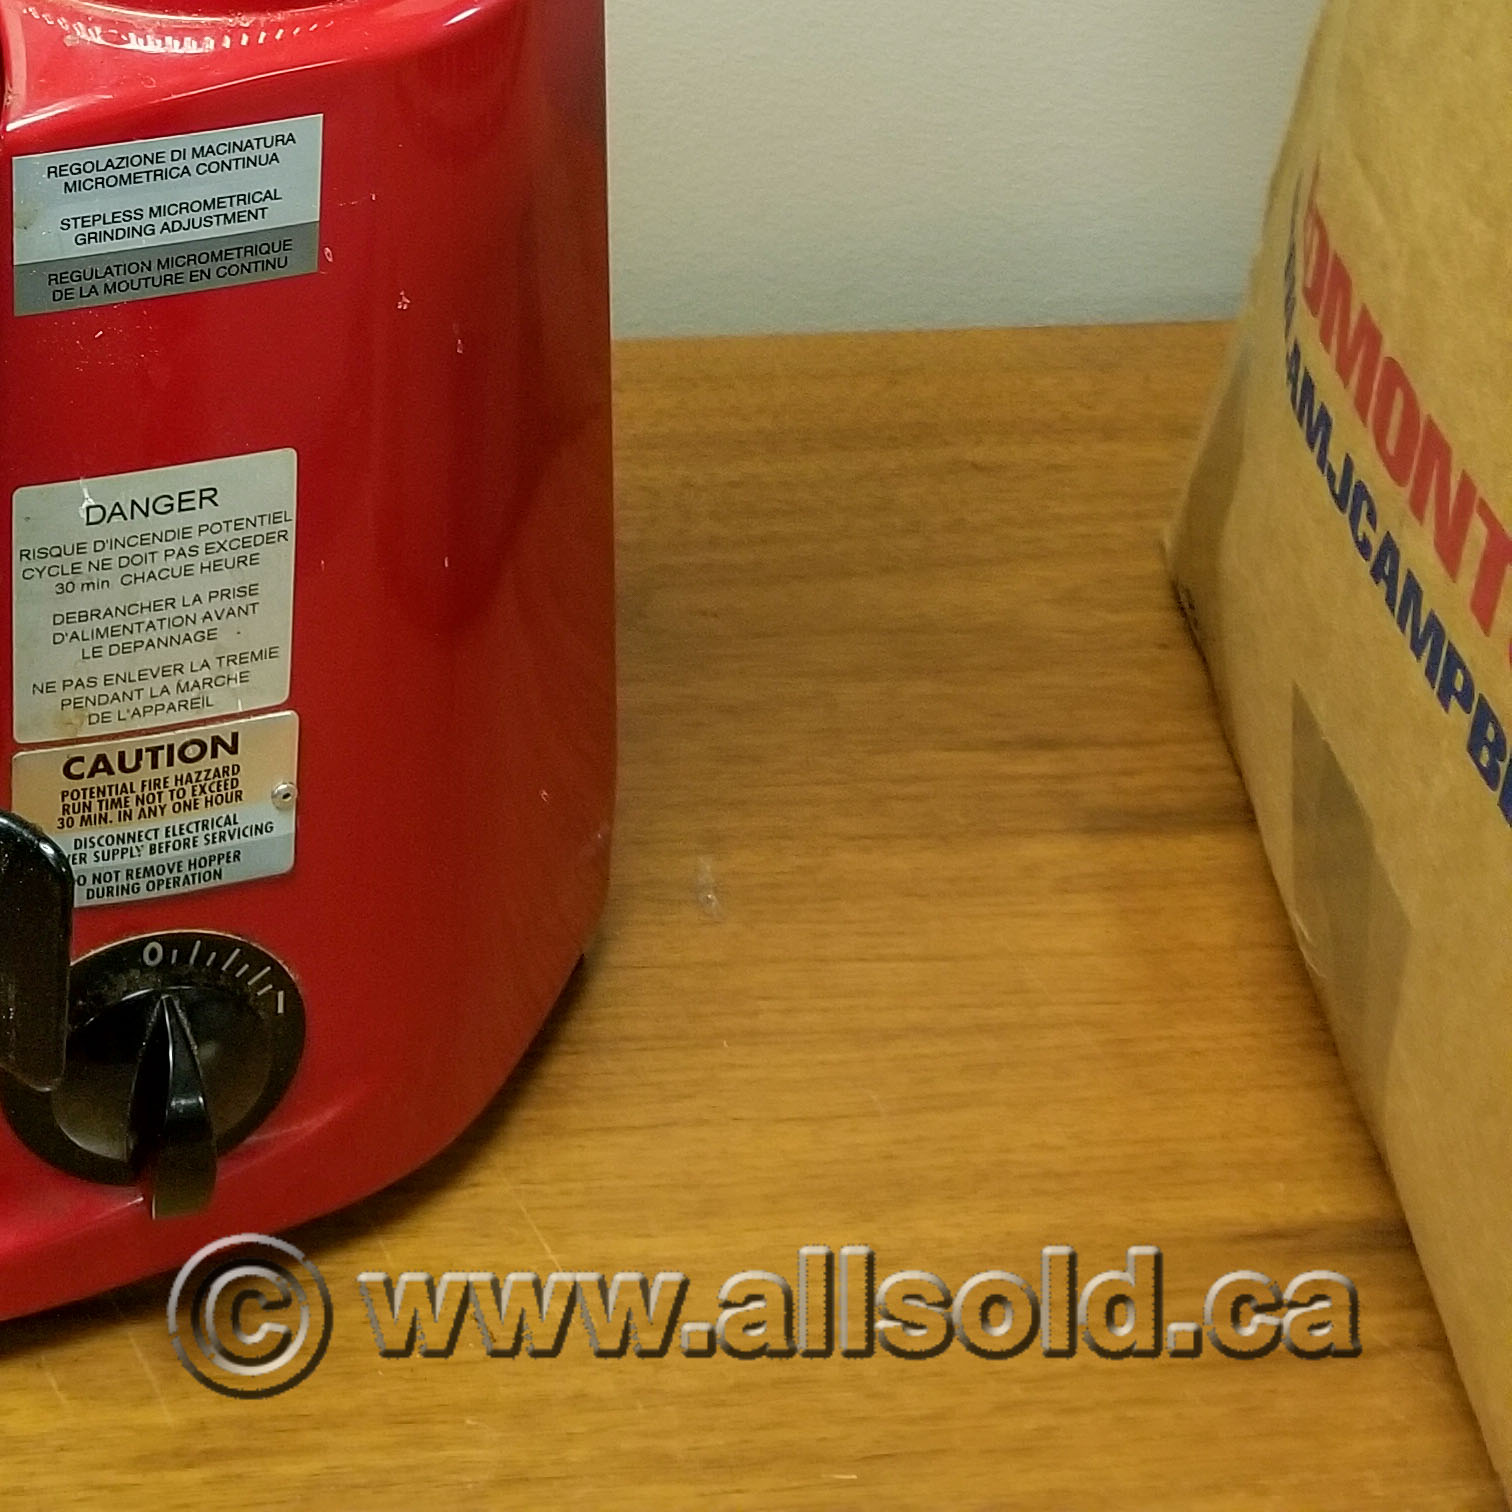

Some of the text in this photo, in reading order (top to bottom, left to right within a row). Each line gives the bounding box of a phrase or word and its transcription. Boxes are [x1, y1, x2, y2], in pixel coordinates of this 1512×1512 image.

[46, 132, 297, 179] REGOLAZIONE DI MACINATURA
[64, 152, 280, 194] MICROMETRICA CONTINUA
[60, 188, 283, 231] STEPLESS MICROMETRICAL
[74, 207, 269, 246] GRINDING ADJUSTMENT
[48, 239, 294, 287] REGULATION MICROMETRIQUE
[52, 256, 289, 303] DE LA MOUTURE EN CONTINU
[1301, 196, 1512, 638] DMONT
[85, 487, 219, 526] DANGER
[19, 511, 293, 562] RISQUE D'INCENDIE POTENTIEL
[21, 529, 289, 581] CYCLE NE DOIT PAS EXCEDER
[55, 553, 261, 595] 30 min CHACUE HEURE
[52, 583, 260, 626] DEBRANCHER LA PRISE
[52, 601, 260, 645] D'ALIMENTATION AVANT
[81, 628, 218, 660] LE DEPANNAGE
[32, 646, 280, 696] NE PAS ENLEVER LA TREMIE
[60, 670, 251, 712] PENDANT LA MARCHE
[88, 696, 214, 726] DE L'APPAREIL
[62, 732, 239, 781] CAUTION
[60, 763, 241, 803] POTENTIAL FIRE HAZZARD
[61, 778, 239, 817] RUN TIME NOT TO EXCEED
[57, 789, 243, 830] 30 MIN. IN ANY ONE HOUR
[73, 813, 239, 851] DISCONNECT ELECTRICAL
[93, 844, 144, 863] SUPPLY
[149, 836, 198, 856] BEFORE
[203, 821, 274, 846] SERVICING
[86, 868, 223, 901] DURING OPERATION
[91, 870, 121, 885] NOT
[125, 861, 183, 881] REMOVE
[187, 849, 241, 872] HOPPER
